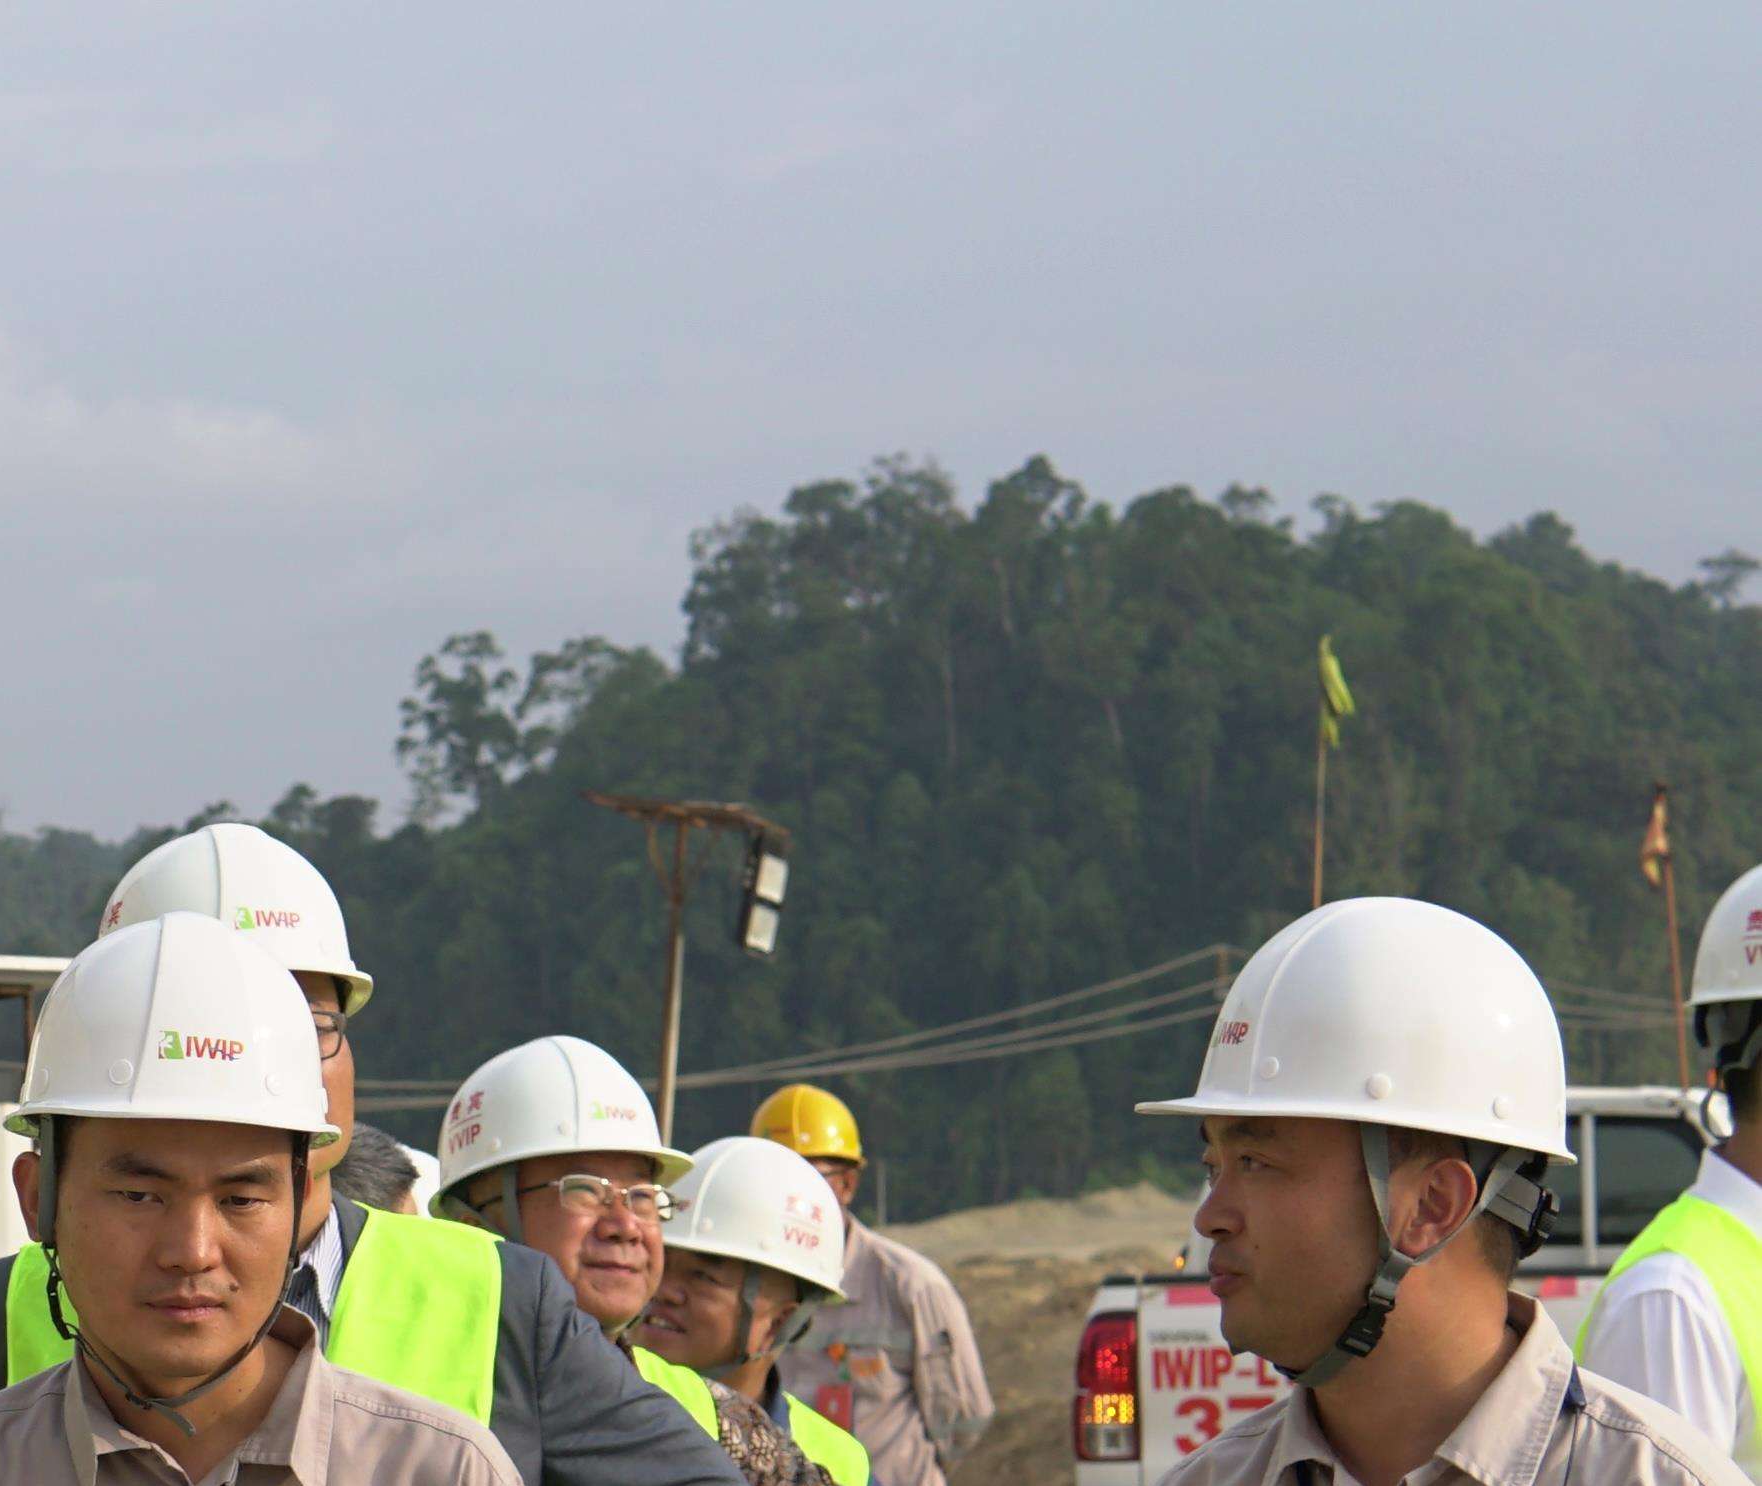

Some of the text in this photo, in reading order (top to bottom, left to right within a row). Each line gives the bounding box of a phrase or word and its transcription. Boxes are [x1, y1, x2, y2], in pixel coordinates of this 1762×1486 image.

[255, 910, 301, 929] IWIP
[186, 1036, 244, 1061] IWIP
[449, 1123, 482, 1155] VVIP
[784, 1226, 820, 1249] VVIP
[1152, 1346, 1298, 1391] IWIP-L
